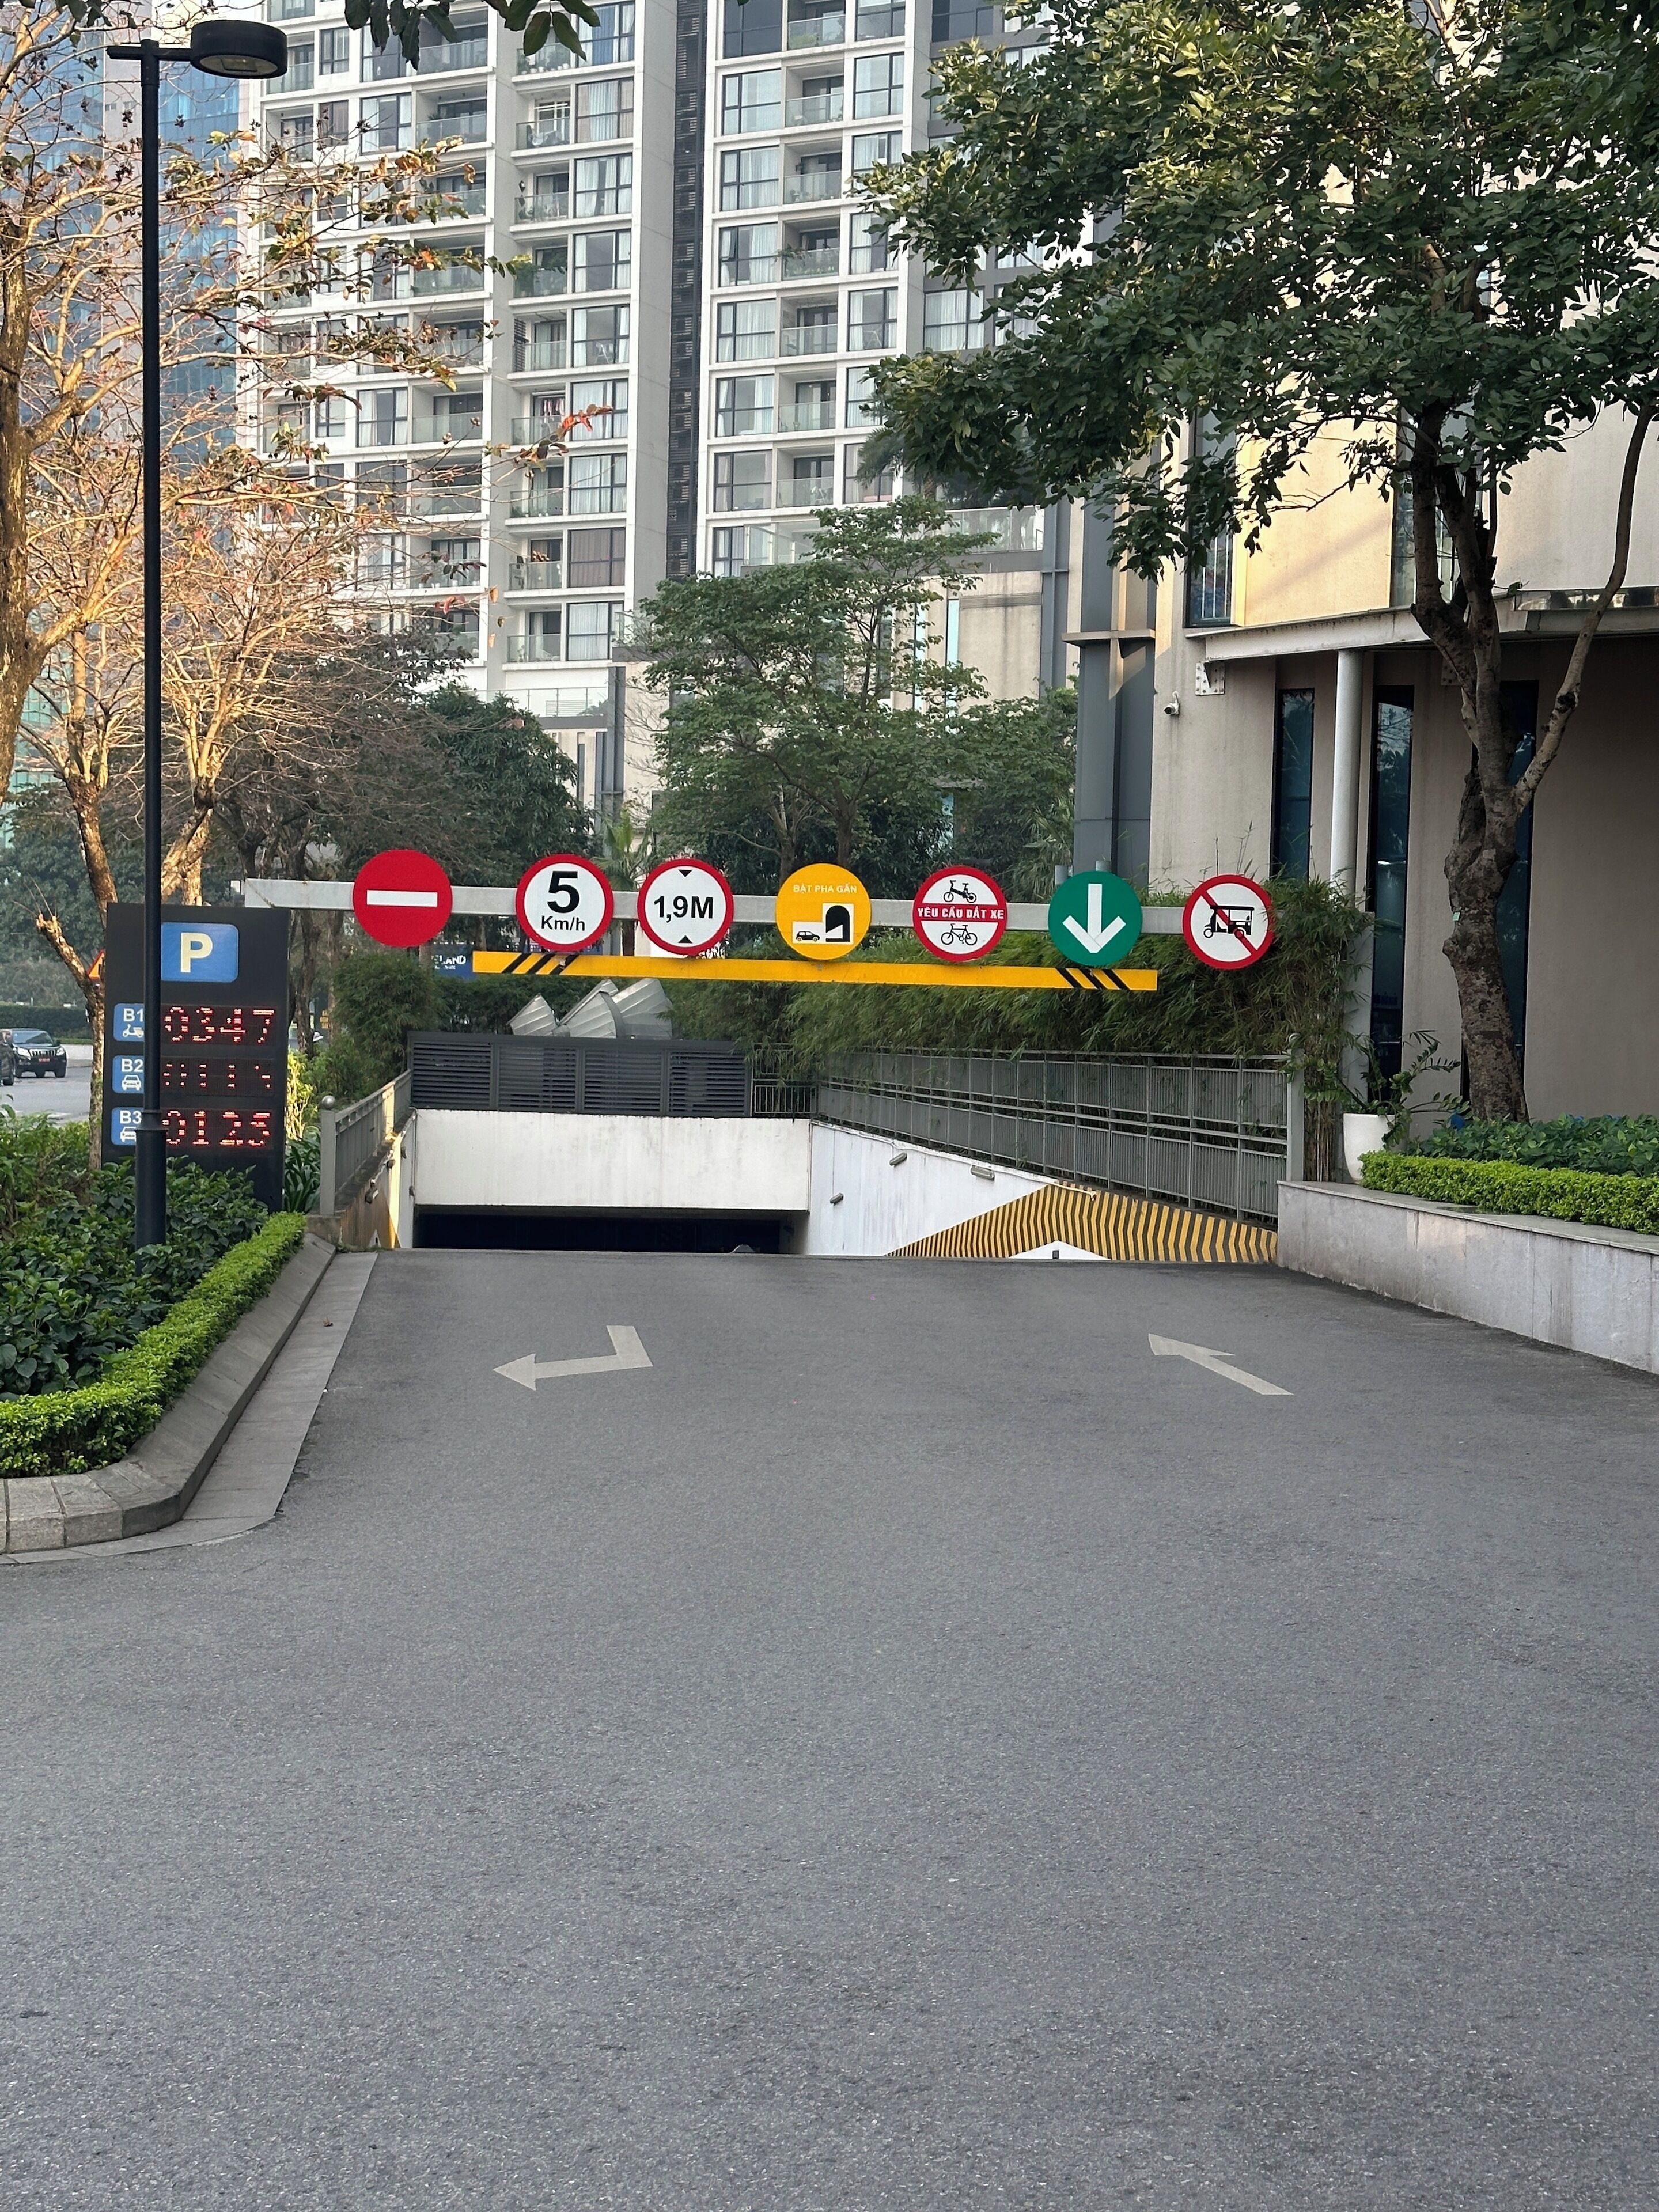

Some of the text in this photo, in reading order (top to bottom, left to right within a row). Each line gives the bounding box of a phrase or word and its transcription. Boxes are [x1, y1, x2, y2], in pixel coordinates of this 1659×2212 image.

[547, 870, 580, 914] 5
[793, 882, 812, 894] BẬT
[815, 884, 834, 893] PHA
[654, 895, 714, 923] 1,9M
[917, 906, 938, 918] YÊU
[942, 906, 963, 918] CẦU
[990, 910, 1004, 919] XE
[541, 916, 585, 931] Km/h
[180, 932, 213, 973] P
[123, 1008, 143, 1022] B1
[165, 1007, 275, 1042] 0347
[122, 1059, 143, 1073] B2
[120, 1110, 142, 1124] B3
